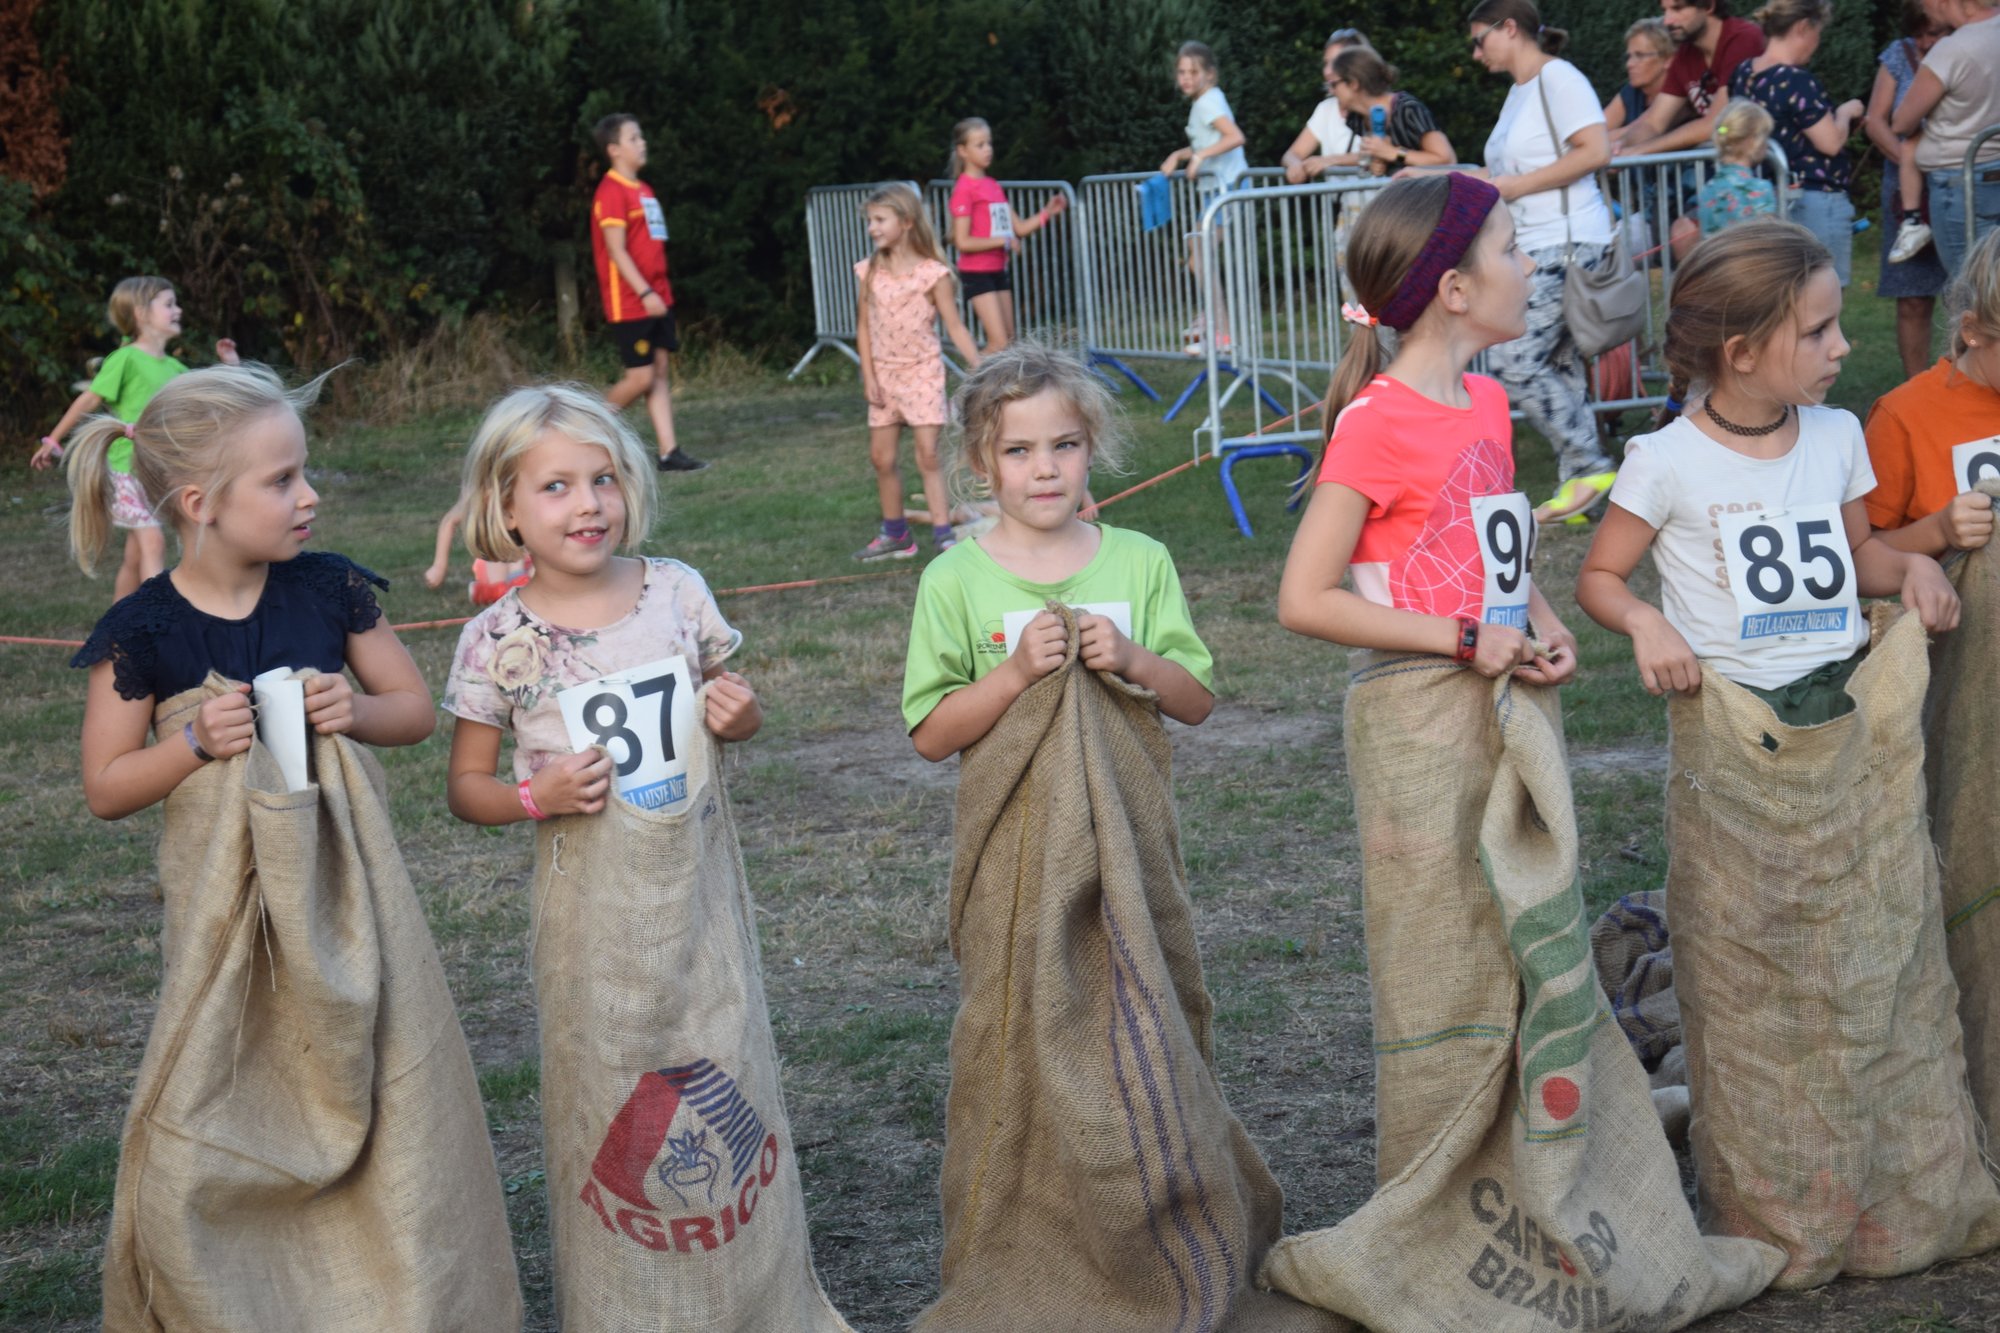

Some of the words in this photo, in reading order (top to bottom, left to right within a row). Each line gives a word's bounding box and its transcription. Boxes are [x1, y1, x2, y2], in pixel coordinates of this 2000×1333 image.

[1739, 519, 1846, 605] 85
[1745, 616, 1766, 637] HET
[1764, 613, 1806, 635] LAATSTE
[1803, 610, 1844, 630] NIEUWS
[582, 672, 677, 777] 87
[578, 1132, 779, 1254] AGRICO
[1466, 1243, 1625, 1333] BRASIL
[1573, 1209, 1618, 1279] DO
